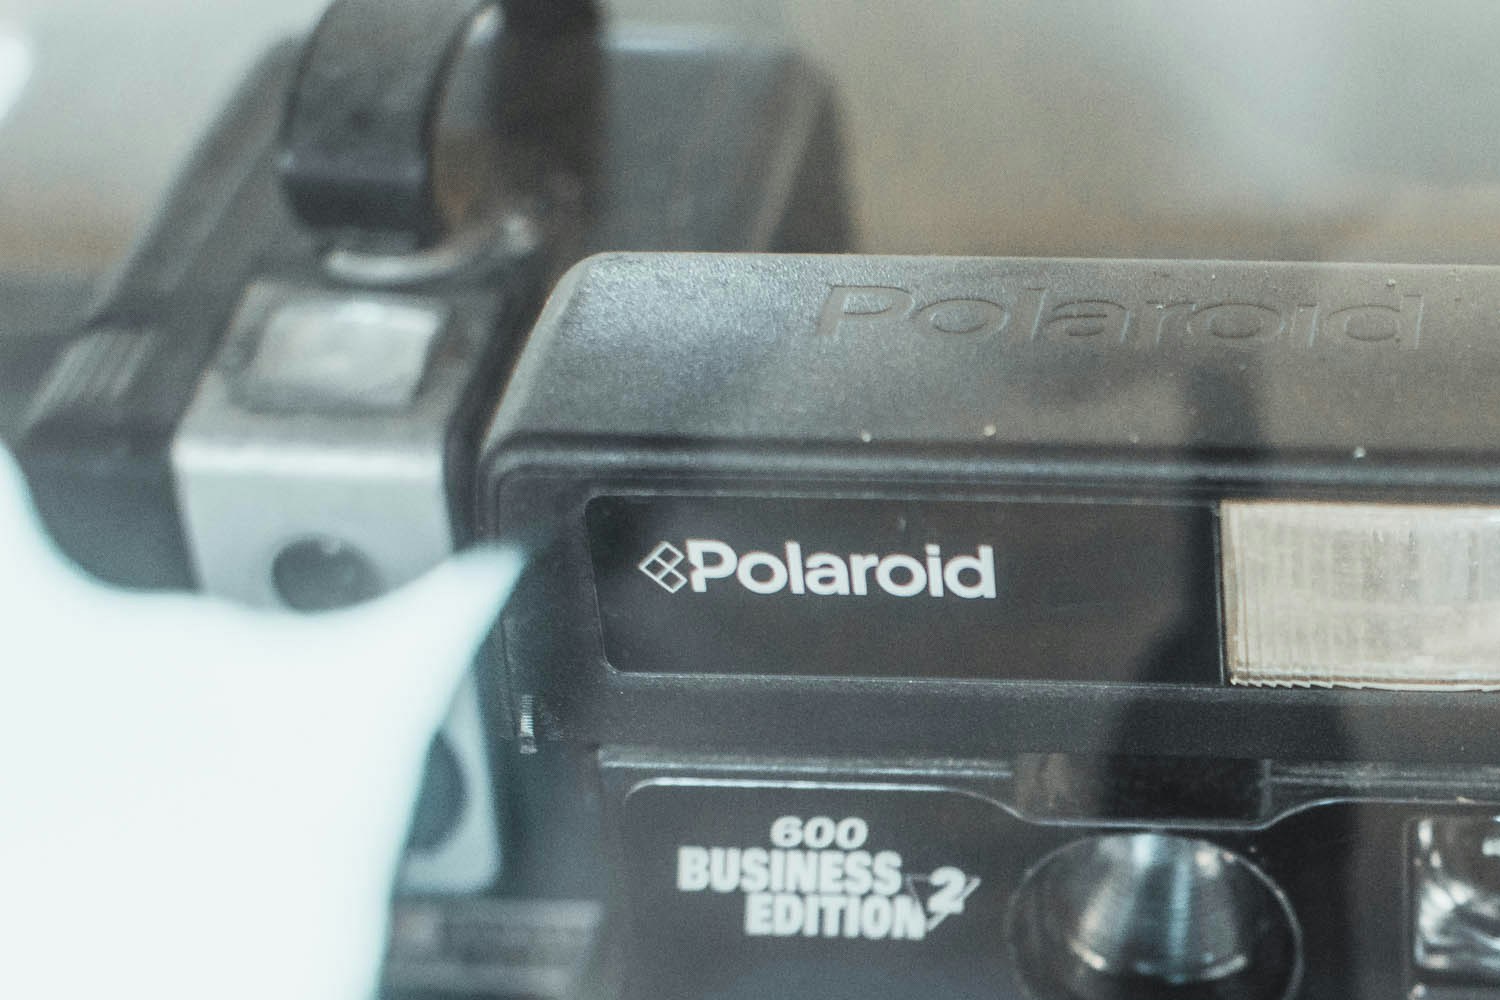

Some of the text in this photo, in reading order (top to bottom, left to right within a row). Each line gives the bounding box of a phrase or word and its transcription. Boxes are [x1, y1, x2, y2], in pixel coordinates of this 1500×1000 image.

[818, 284, 1424, 348] Polaroid
[687, 539, 997, 599] Polaroid
[770, 816, 868, 849] 600
[676, 846, 902, 895] BUSINESS
[744, 865, 966, 940] EDITION 2
